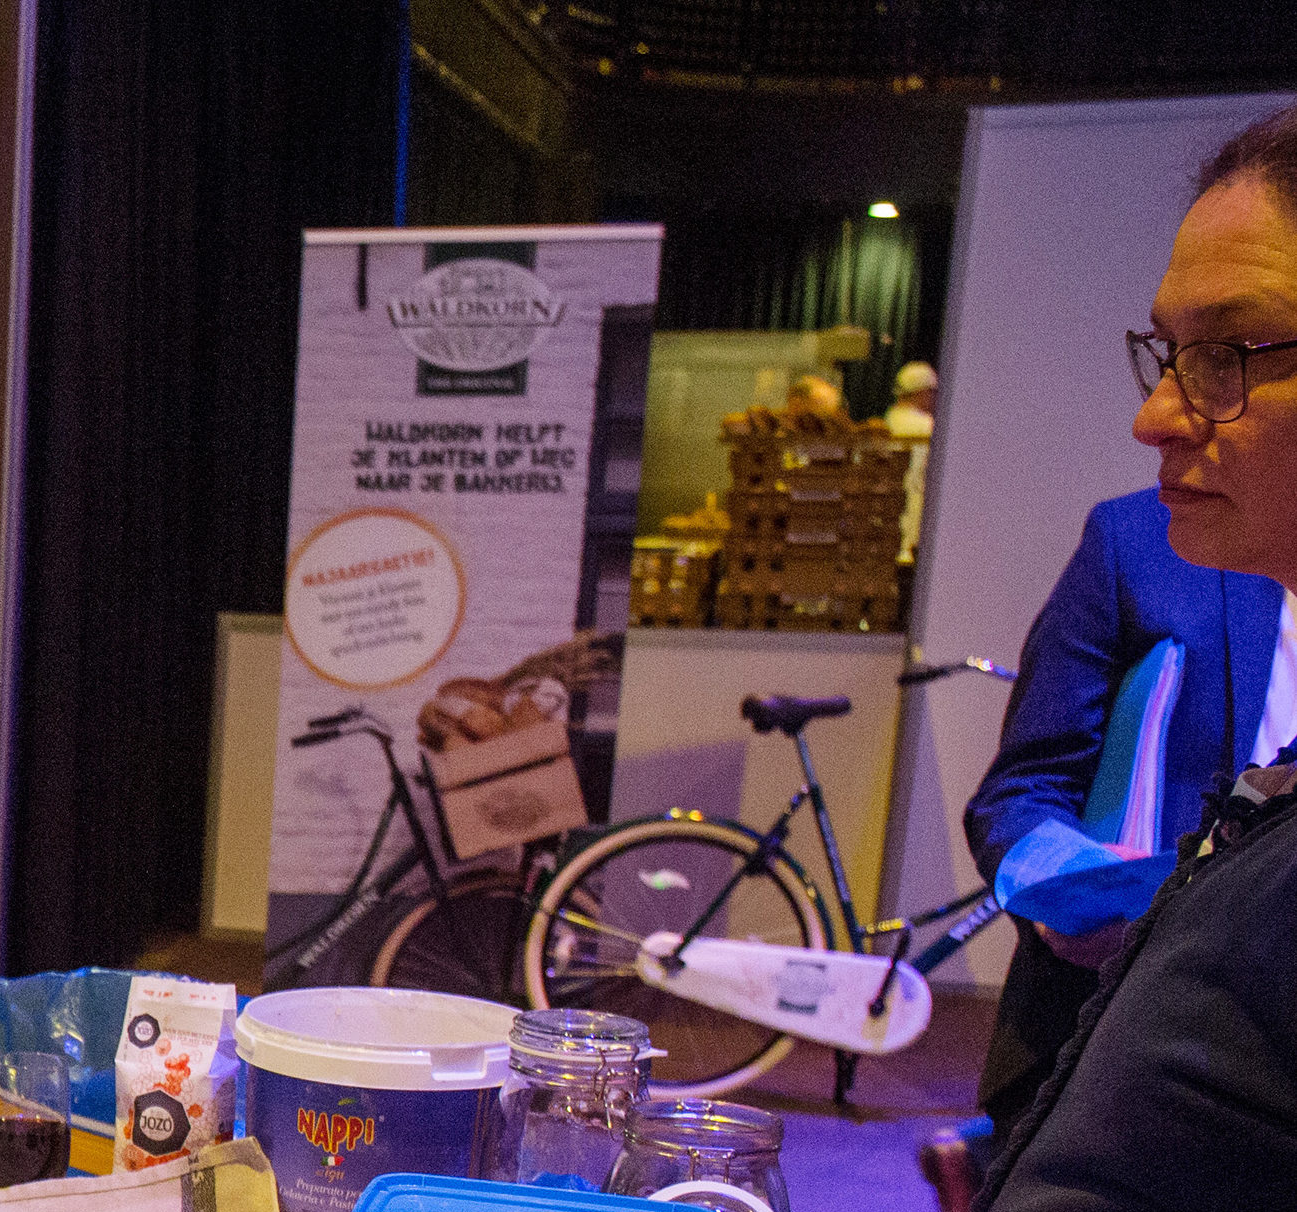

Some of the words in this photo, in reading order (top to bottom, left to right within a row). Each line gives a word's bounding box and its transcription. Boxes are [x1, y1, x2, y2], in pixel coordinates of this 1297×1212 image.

[397, 299, 551, 320] WALDKORN
[365, 421, 483, 443] WALDKORN
[496, 423, 565, 443] HELPT
[351, 449, 376, 468] JE
[387, 449, 486, 468] KLANTEN
[494, 449, 522, 468] OP
[356, 474, 410, 492] NAAR
[420, 474, 445, 492] JE
[297, 1107, 375, 1155] NAPPI
